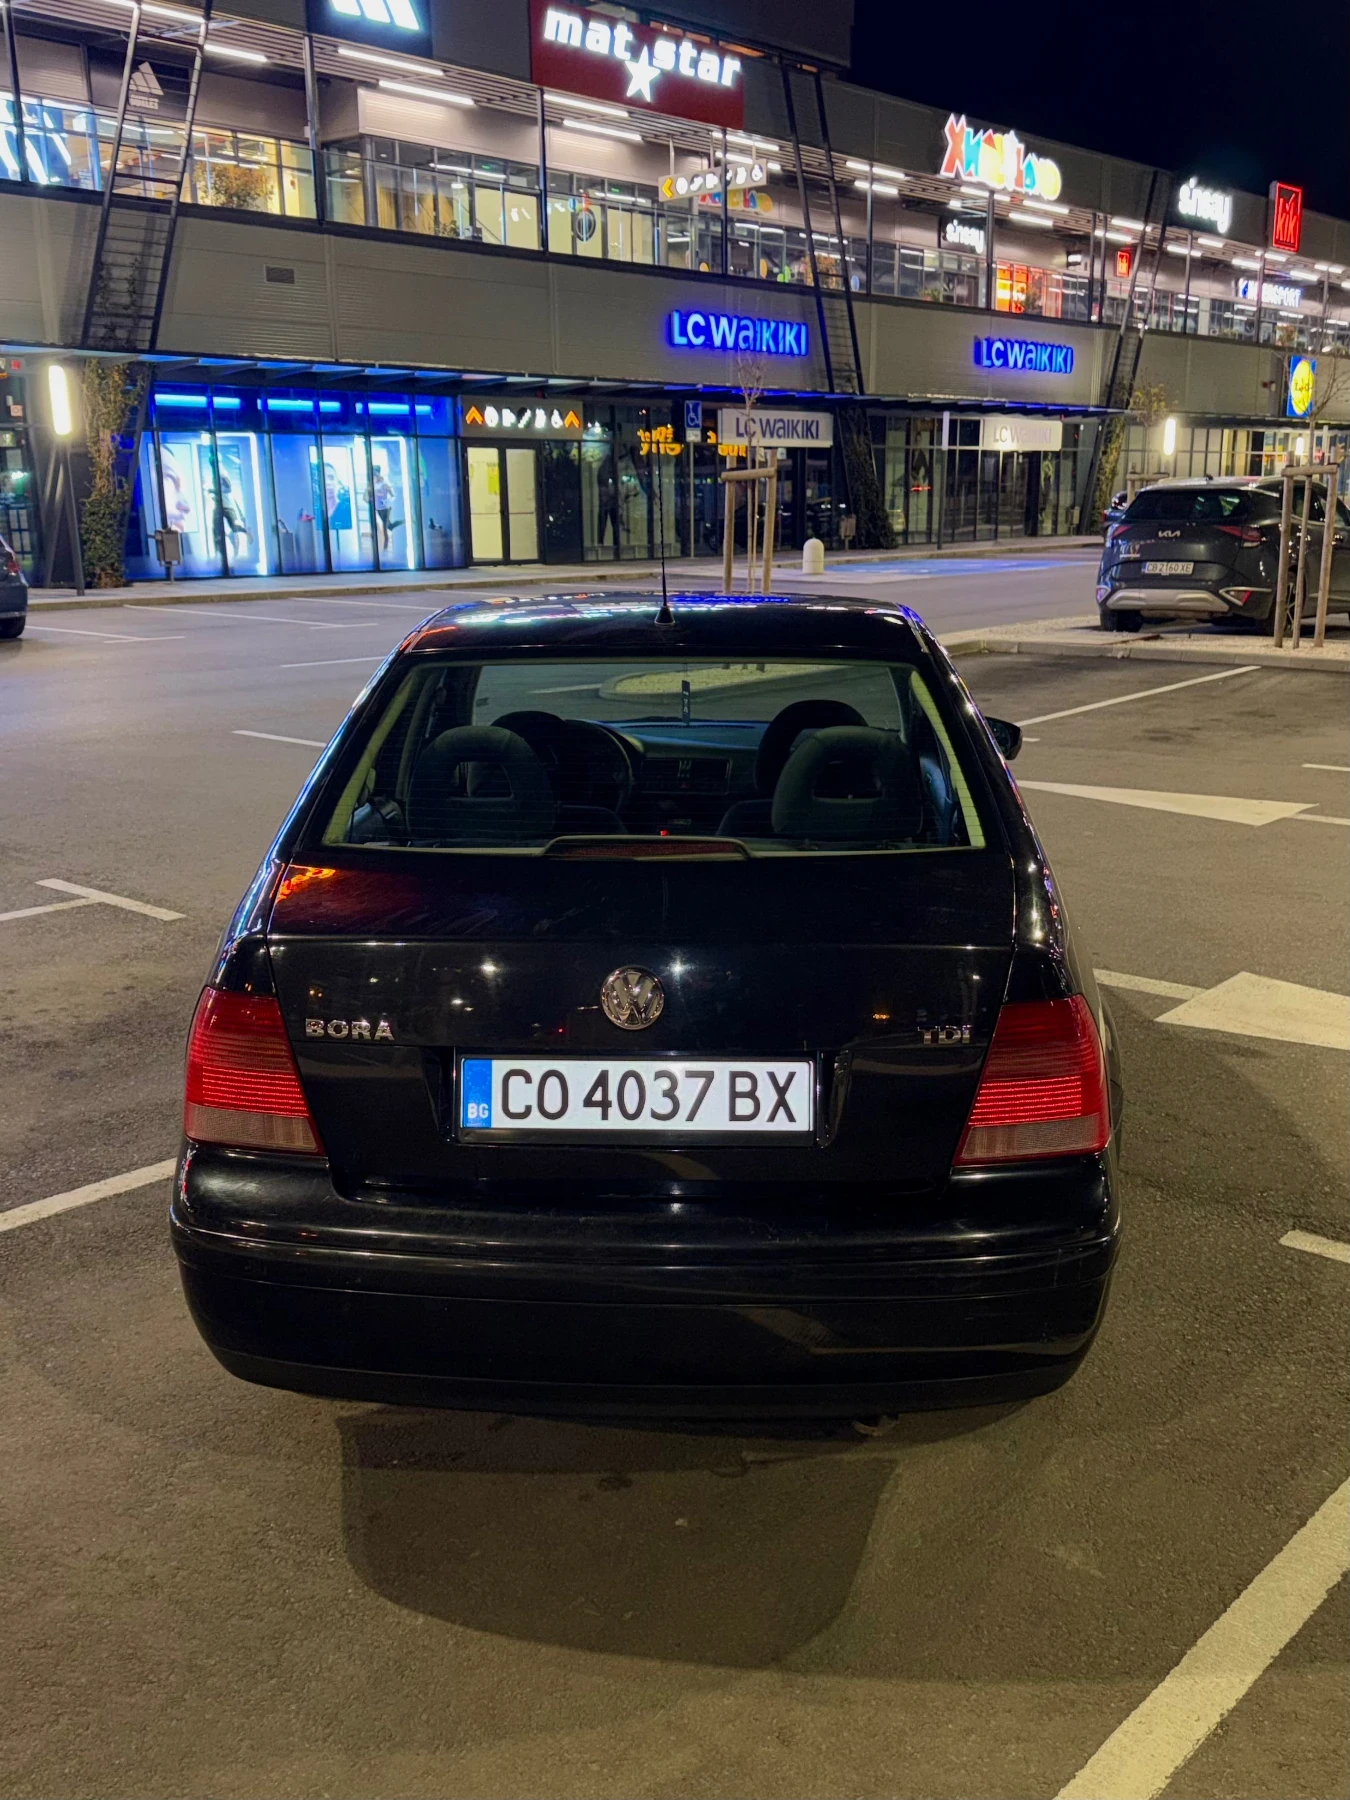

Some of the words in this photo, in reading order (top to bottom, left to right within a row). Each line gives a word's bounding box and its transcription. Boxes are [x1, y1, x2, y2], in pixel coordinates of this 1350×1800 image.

[544, 9, 634, 61] mat
[653, 39, 741, 86] star
[672, 309, 706, 346] LC
[982, 339, 1005, 367] LC
[735, 417, 756, 438] LC
[305, 1018, 395, 1040] BORA
[501, 1069, 569, 1120] CO
[583, 1069, 715, 1122] 4037
[728, 1070, 797, 1122] BX
[467, 1103, 489, 1118] BG
